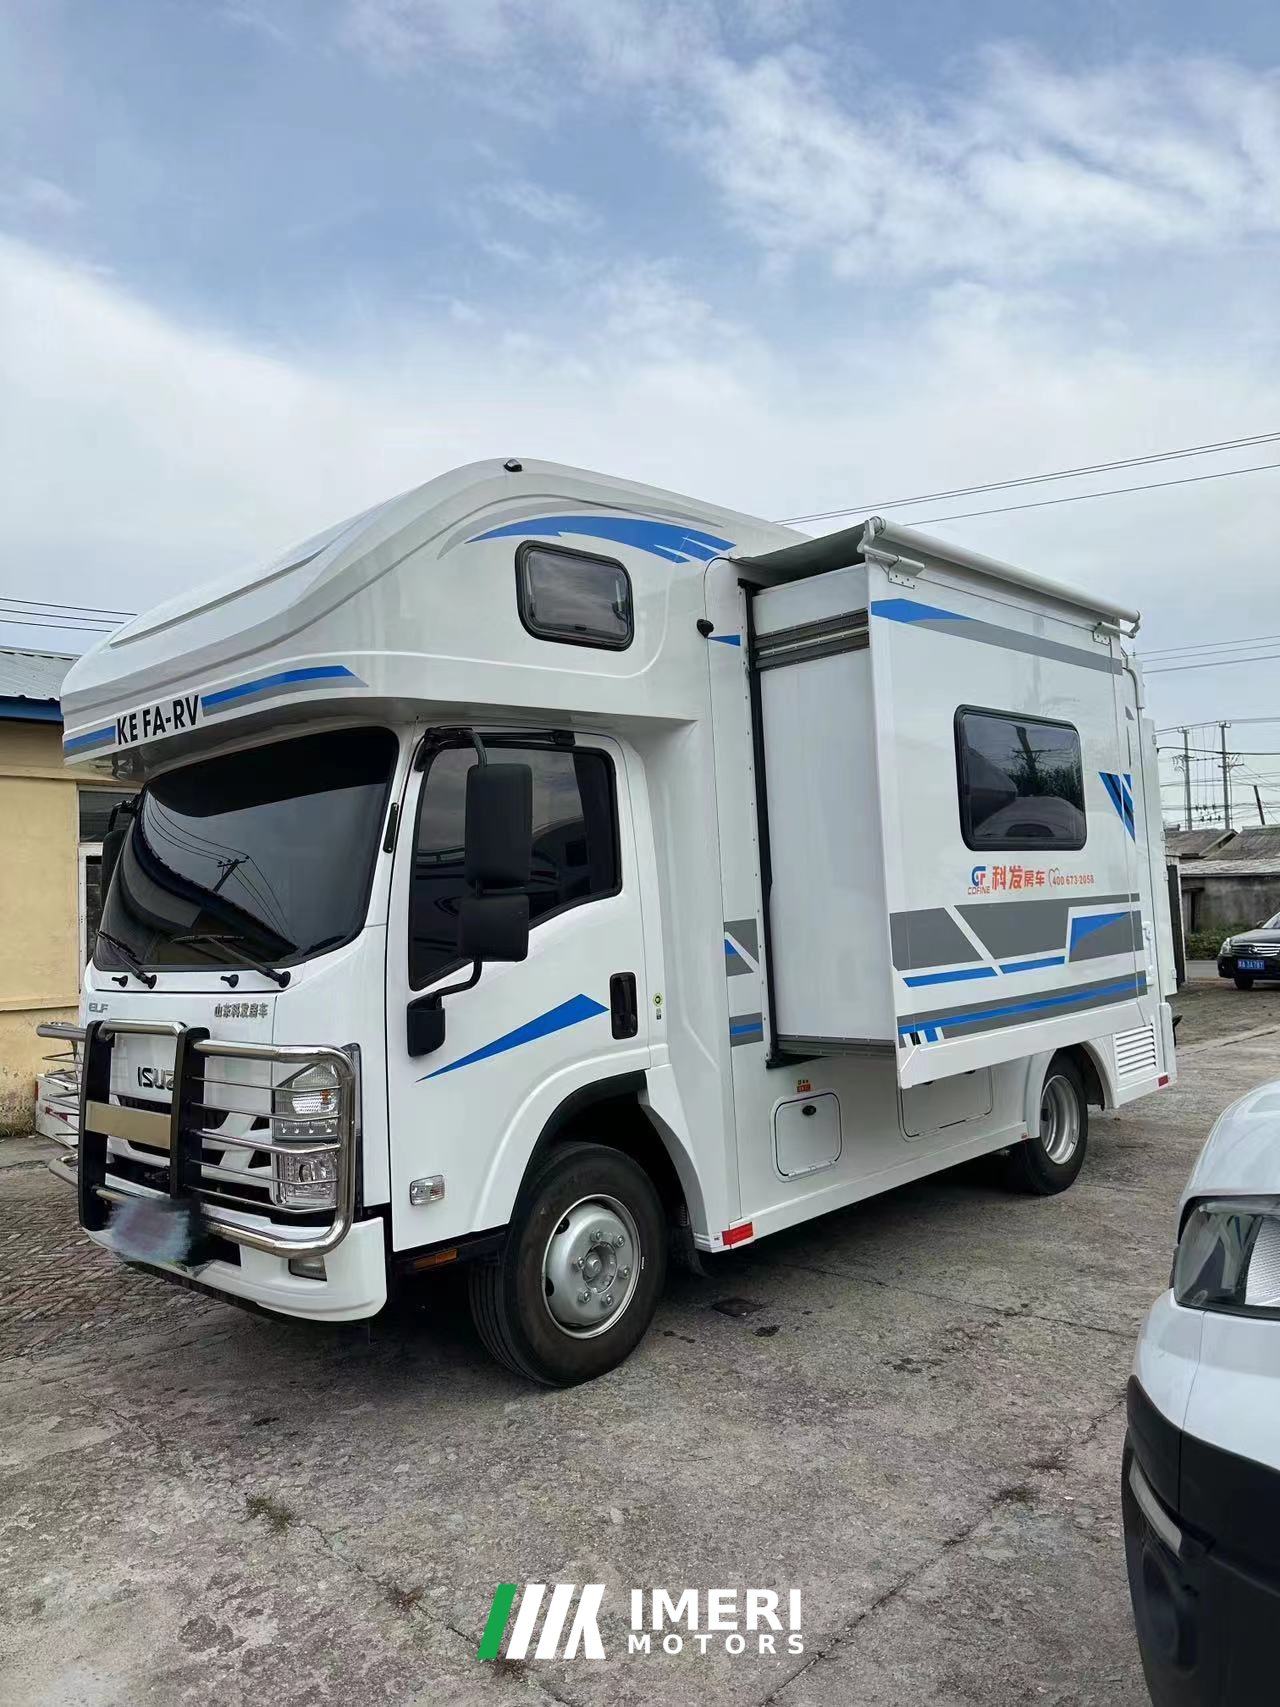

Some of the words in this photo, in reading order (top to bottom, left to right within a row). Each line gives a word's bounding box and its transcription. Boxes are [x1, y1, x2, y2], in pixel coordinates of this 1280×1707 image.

[117, 713, 138, 745] KE
[143, 694, 199, 738] FA-RV
[992, 865, 1045, 890] 科发房车
[89, 1002, 108, 1013] ELF
[137, 1066, 175, 1091] ISUZ
